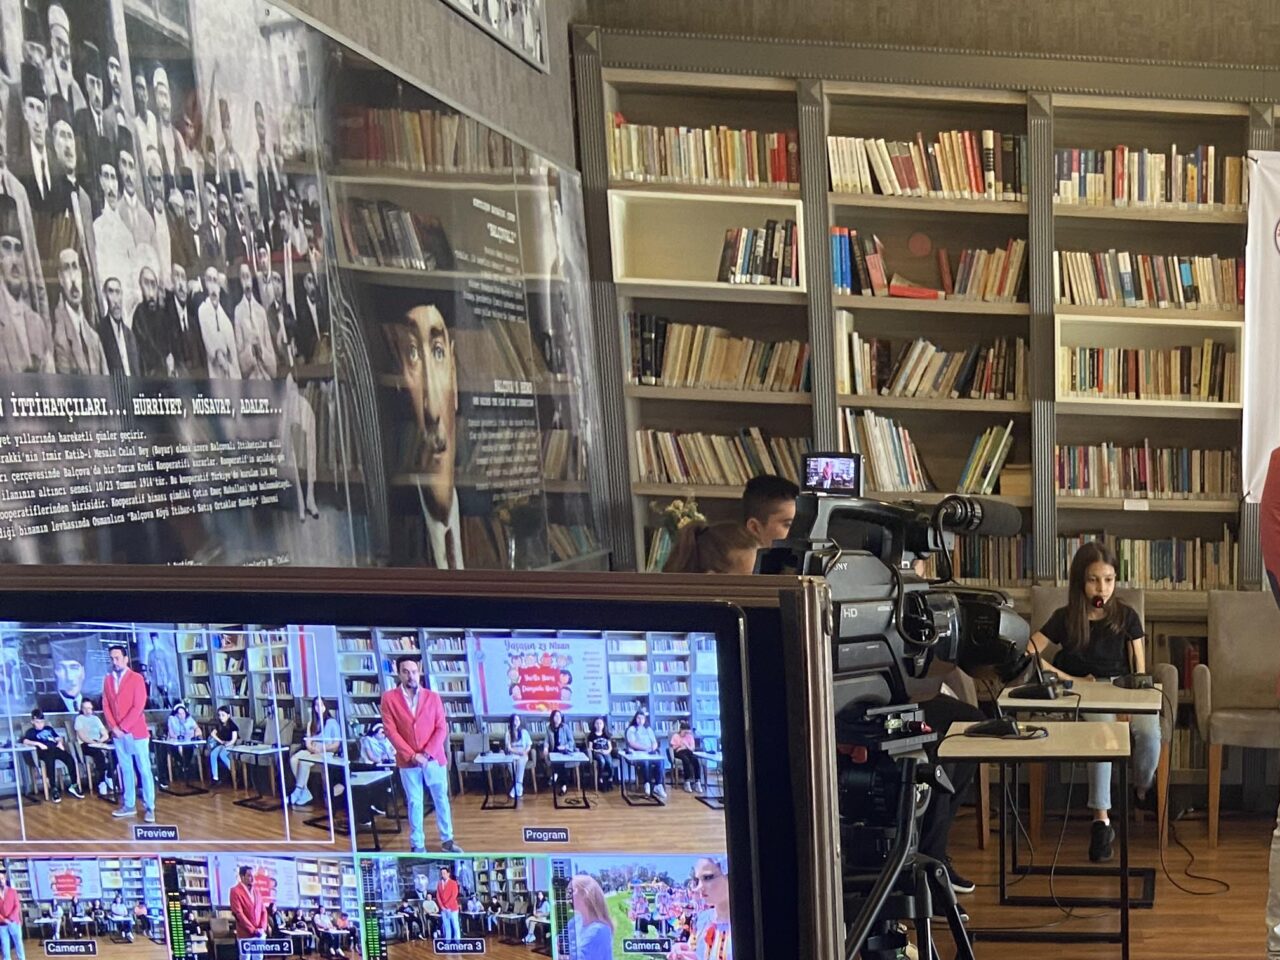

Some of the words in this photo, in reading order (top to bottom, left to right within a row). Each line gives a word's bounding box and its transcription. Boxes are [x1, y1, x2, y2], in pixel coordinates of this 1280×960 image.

[11, 392, 127, 422] İTTİHATÇILARI...
[133, 393, 187, 418] HÜRRİYET,
[192, 394, 236, 418] MÜSAVAT,
[240, 398, 282, 414] ADALET...
[14, 432, 56, 447] yıllarında
[58, 431, 93, 443] hareketli
[96, 480, 113, 492] 10/23
[843, 608, 858, 618] HD
[136, 828, 176, 838] Preview
[526, 829, 566, 841] Program
[48, 943, 85, 952] Camera
[87, 943, 93, 952] 1
[243, 942, 280, 951] Camera
[282, 941, 289, 950] 2
[437, 941, 472, 951] Camera
[475, 941, 482, 950] 3
[625, 941, 660, 951] Camera
[662, 940, 669, 950] 4
